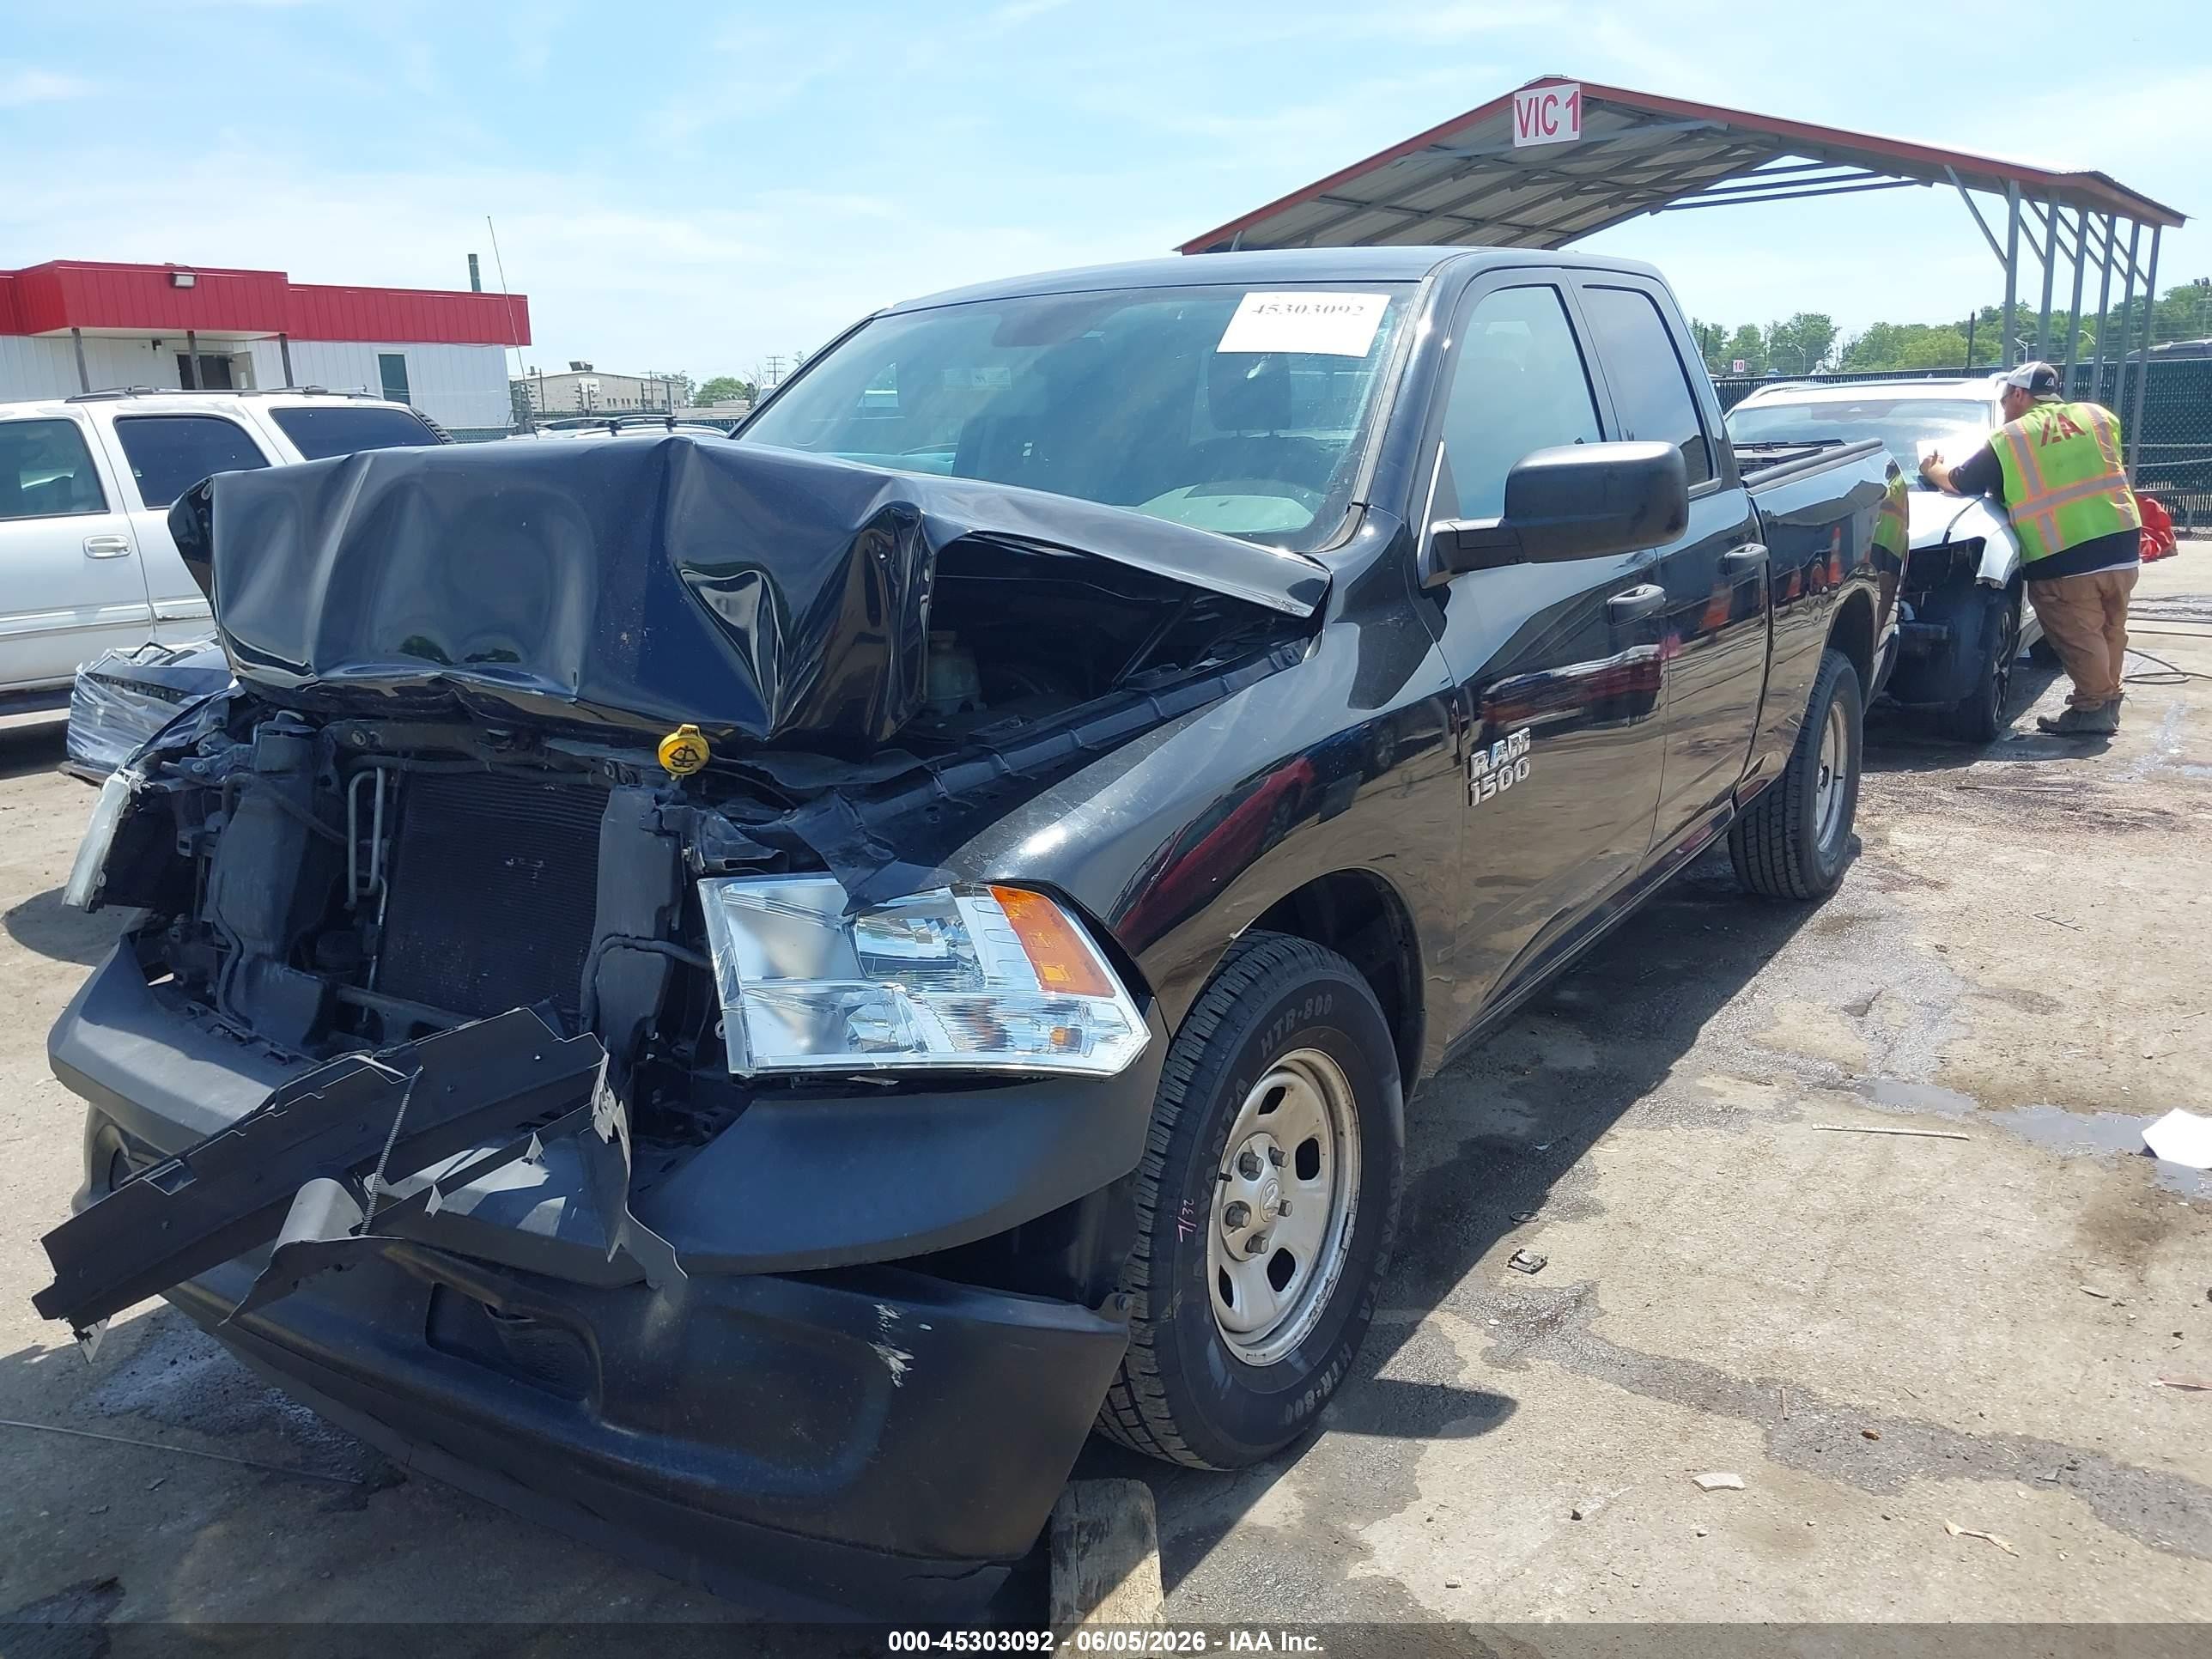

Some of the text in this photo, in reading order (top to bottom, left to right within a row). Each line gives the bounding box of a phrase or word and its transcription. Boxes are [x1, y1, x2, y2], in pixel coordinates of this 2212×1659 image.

[1516, 90, 1579, 138] VIC 1
[1250, 303, 1364, 316] 45303092
[1735, 362, 1744, 370] 10
[1469, 727, 1531, 781] RAM
[1468, 756, 1531, 807] 1500
[1260, 994, 1334, 1060] HTR-800
